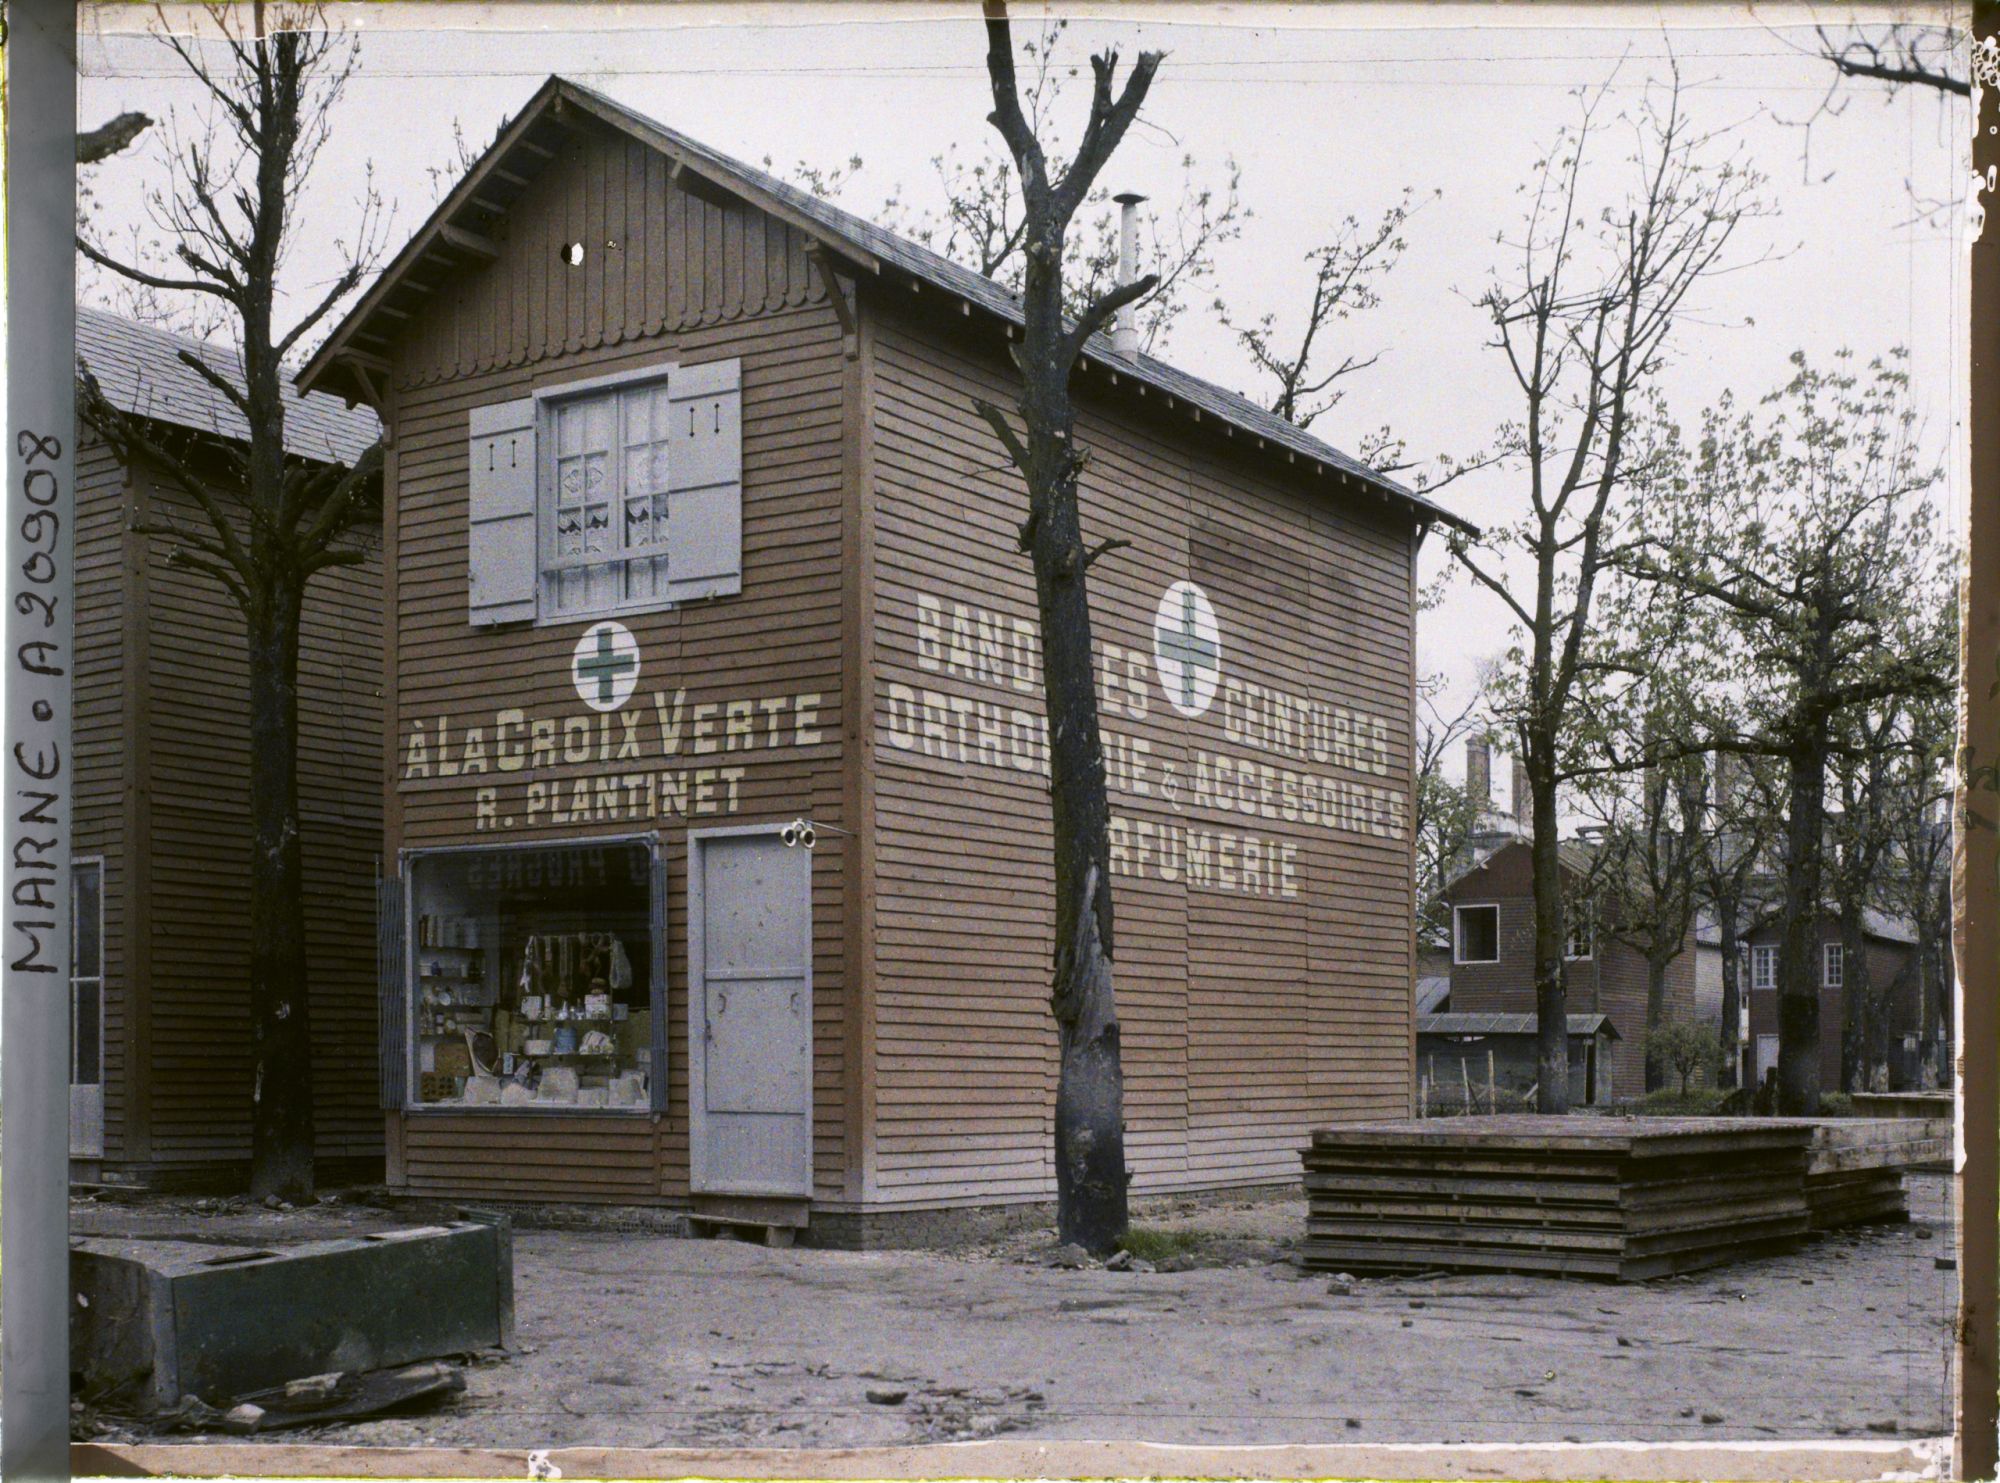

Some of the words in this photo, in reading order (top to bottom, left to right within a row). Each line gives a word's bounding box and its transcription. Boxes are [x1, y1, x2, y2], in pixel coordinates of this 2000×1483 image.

[917, 593, 1149, 720] BANDES
[1224, 678, 1388, 776] CEINTURES
[438, 715, 488, 775] LA
[496, 708, 642, 771] CROIX
[653, 687, 822, 756] VERTE
[475, 787, 514, 830] R.
[526, 767, 745, 825] PLANTINET
[1160, 761, 1182, 812] &
[1194, 751, 1404, 840] ACCESSOIRES
[11, 741, 59, 973] MARNE
[1108, 816, 1298, 898] RFUMERIE
